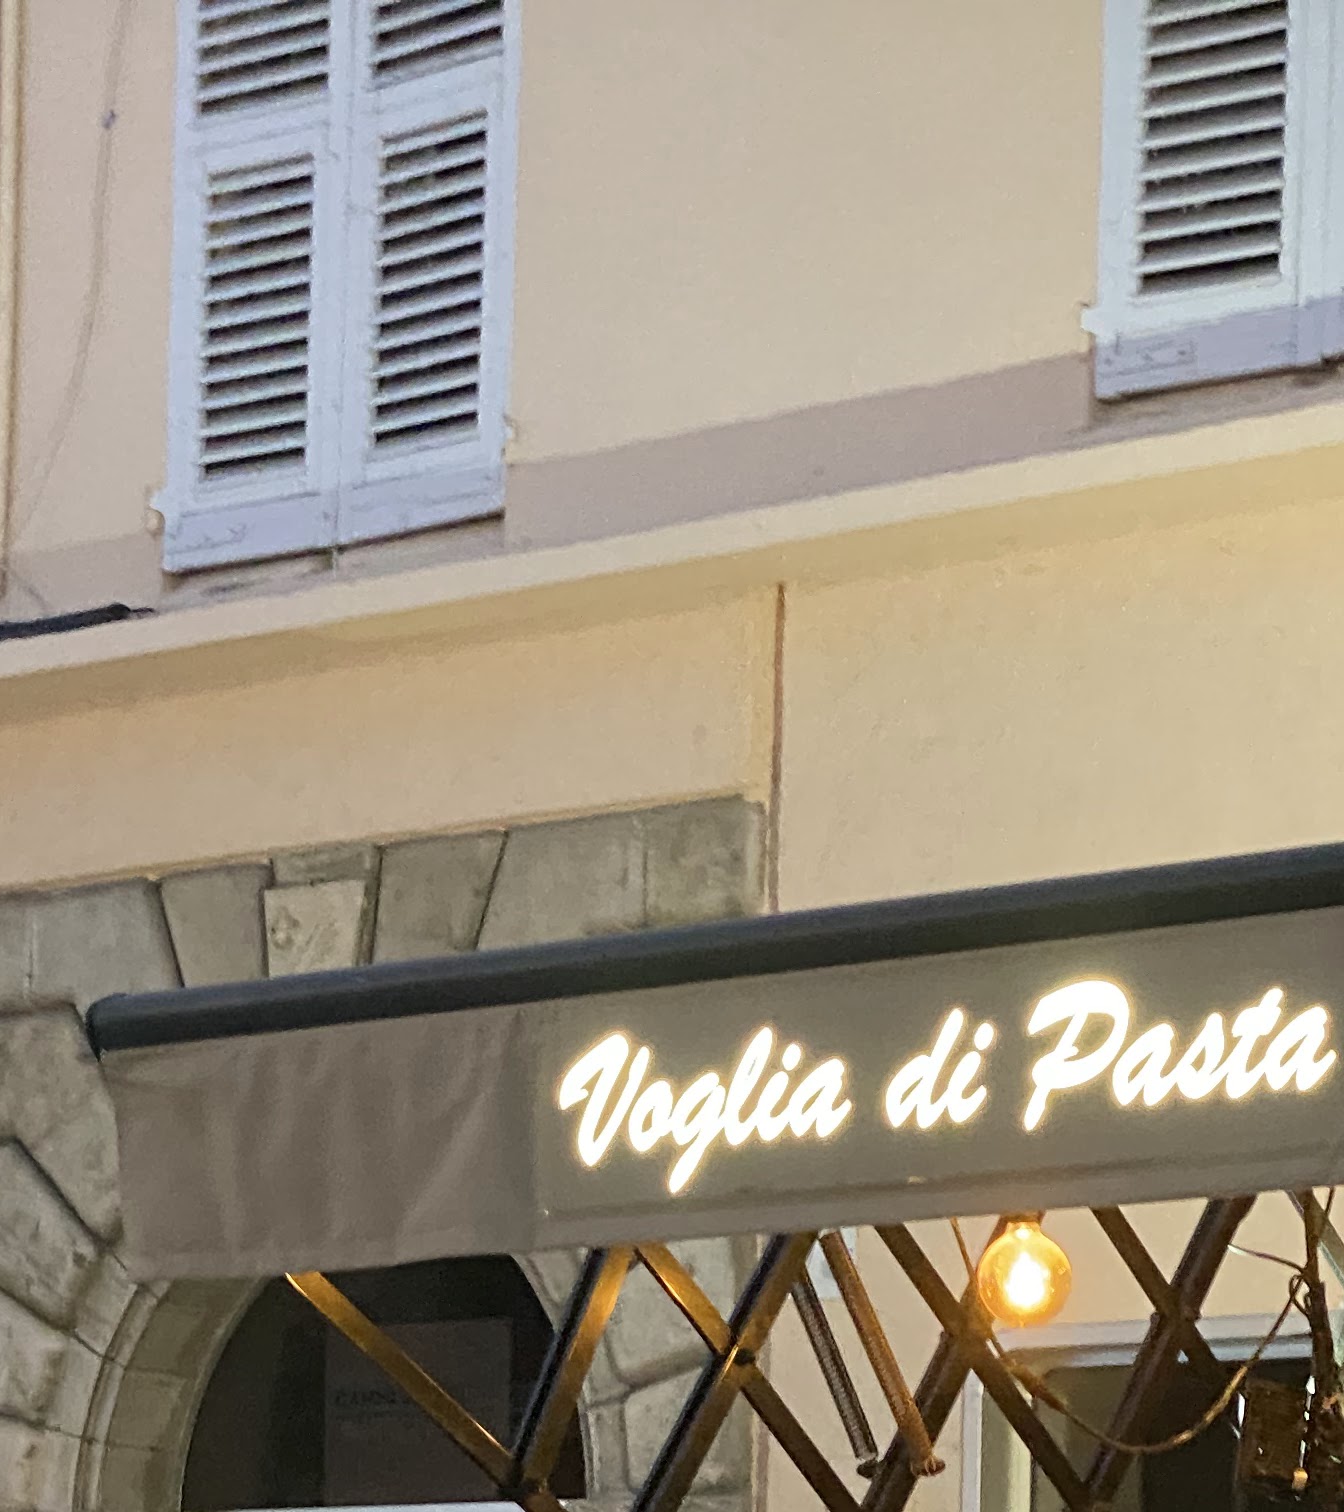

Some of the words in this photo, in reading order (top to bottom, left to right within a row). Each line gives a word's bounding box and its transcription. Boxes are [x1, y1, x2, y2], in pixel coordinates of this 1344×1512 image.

[558, 1024, 853, 1195] Voglia
[885, 1007, 996, 1131] di
[1023, 979, 1338, 1132] Pasta
